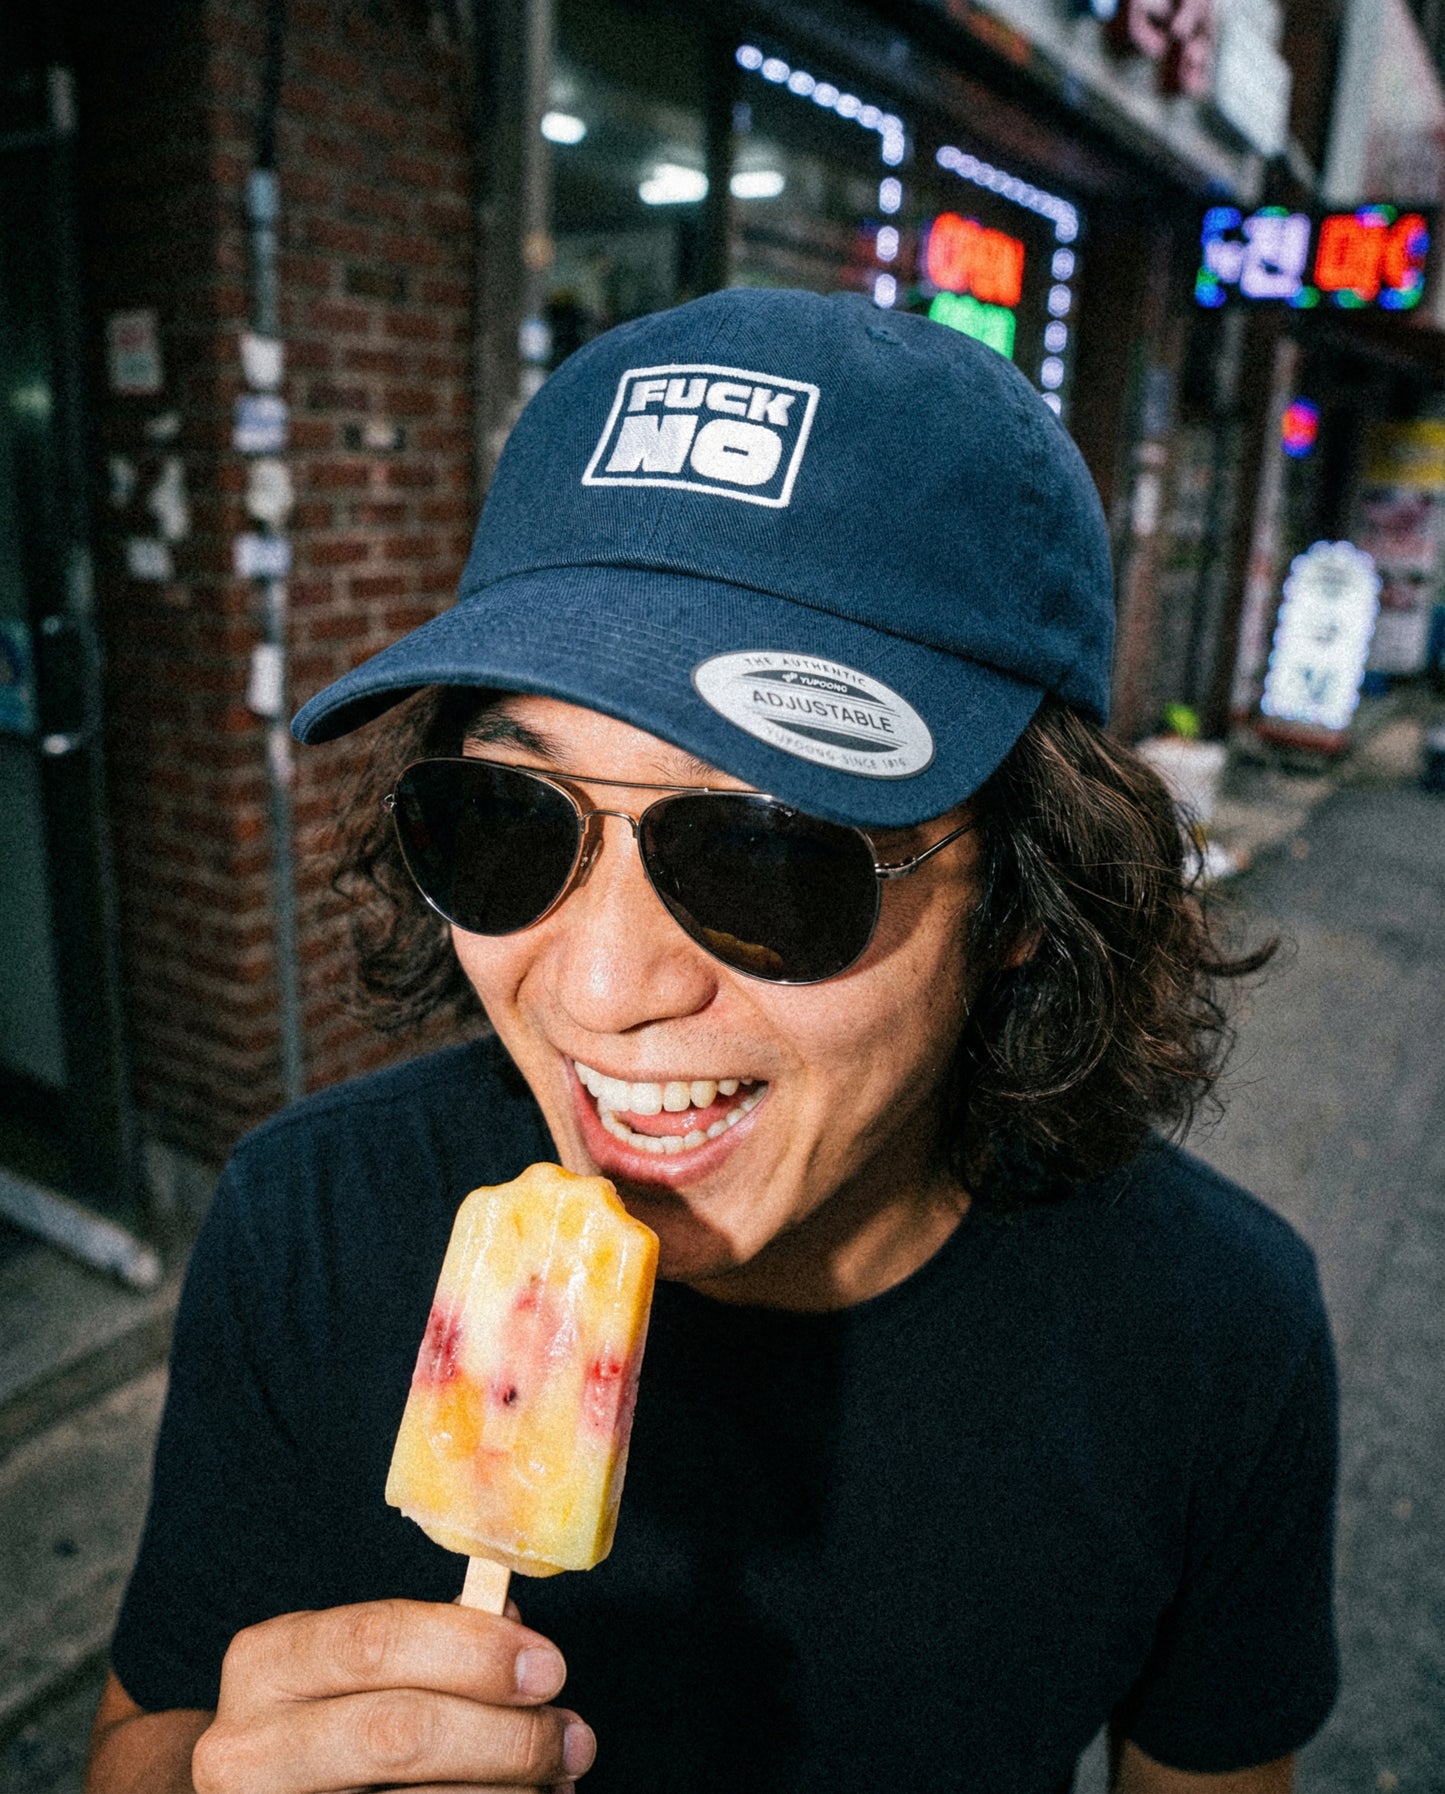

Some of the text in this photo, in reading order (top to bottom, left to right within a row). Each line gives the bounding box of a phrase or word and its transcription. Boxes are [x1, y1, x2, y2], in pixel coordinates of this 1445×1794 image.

[627, 378, 796, 427] FUCK
[605, 414, 783, 486] NO
[745, 657, 867, 687] THE AUTHENTIC
[800, 676, 848, 693] YUPOONG
[752, 689, 895, 734] ADJUSTABLE
[842, 753, 878, 770] SINCE
